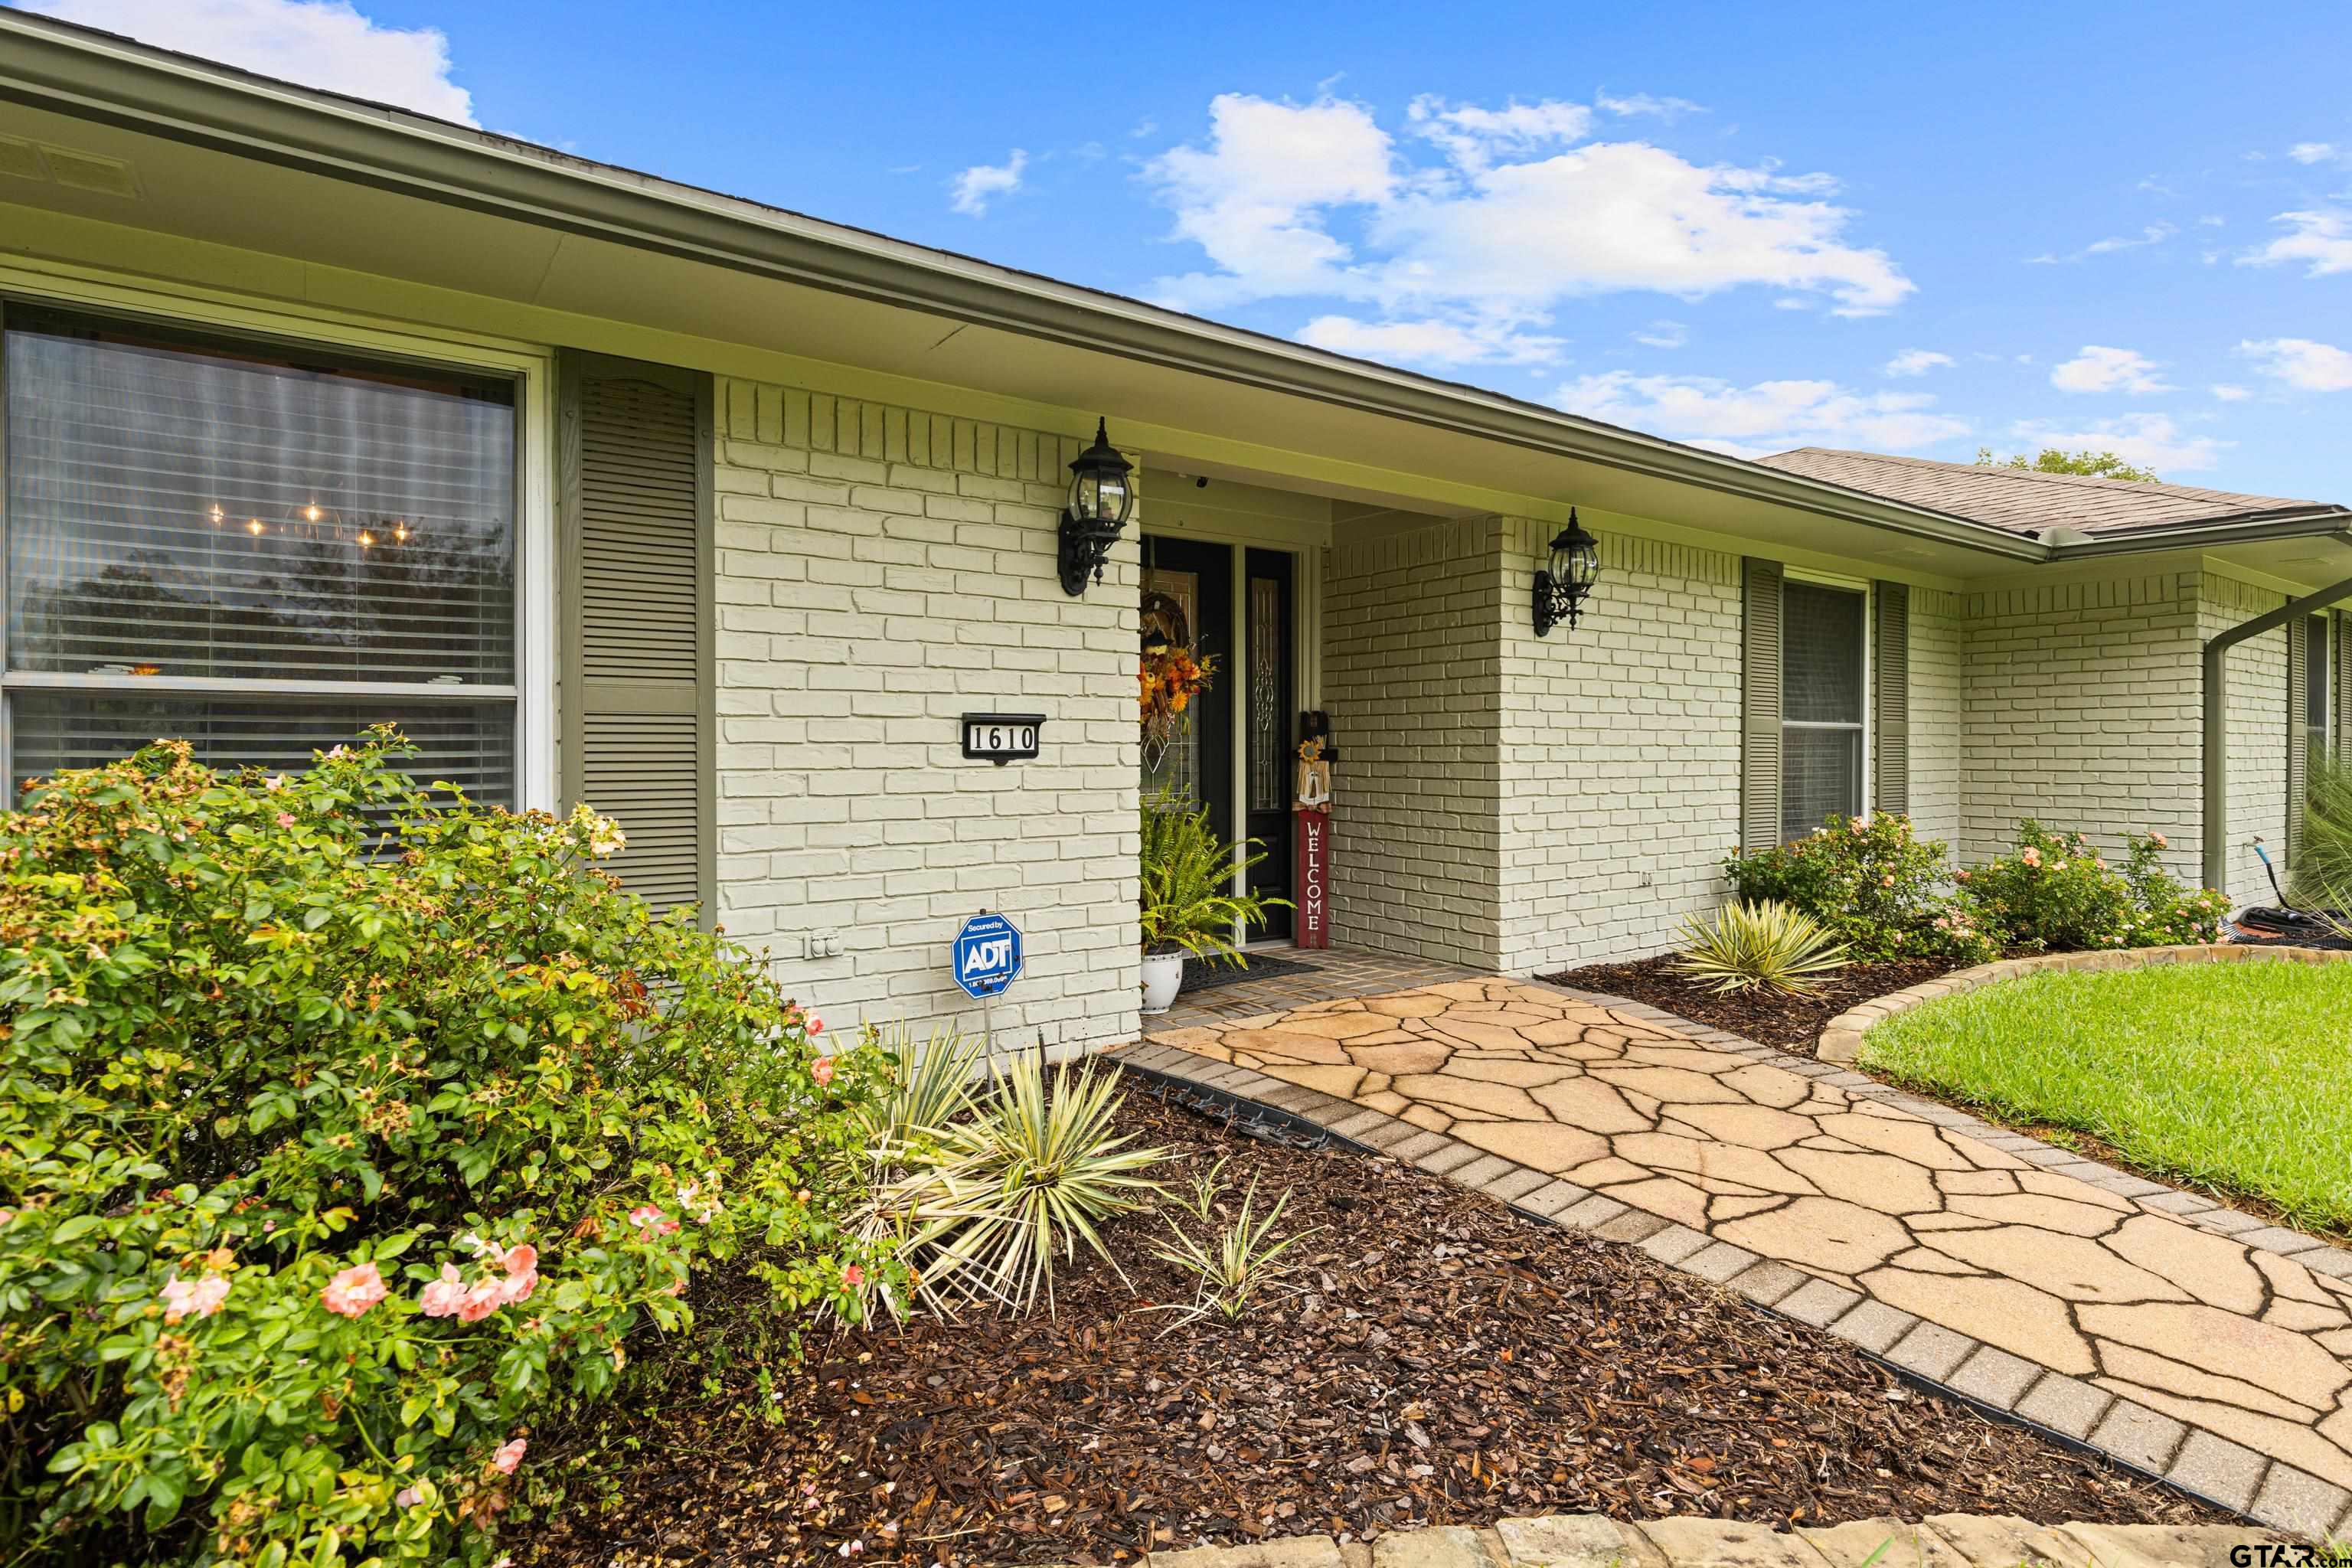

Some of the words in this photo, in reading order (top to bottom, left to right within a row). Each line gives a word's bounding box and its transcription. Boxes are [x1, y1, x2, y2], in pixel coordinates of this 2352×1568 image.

[975, 727, 1033, 750] 1610
[1306, 822, 1321, 930] WELCOME
[968, 921, 994, 932] Secured
[964, 939, 1010, 975] ADT
